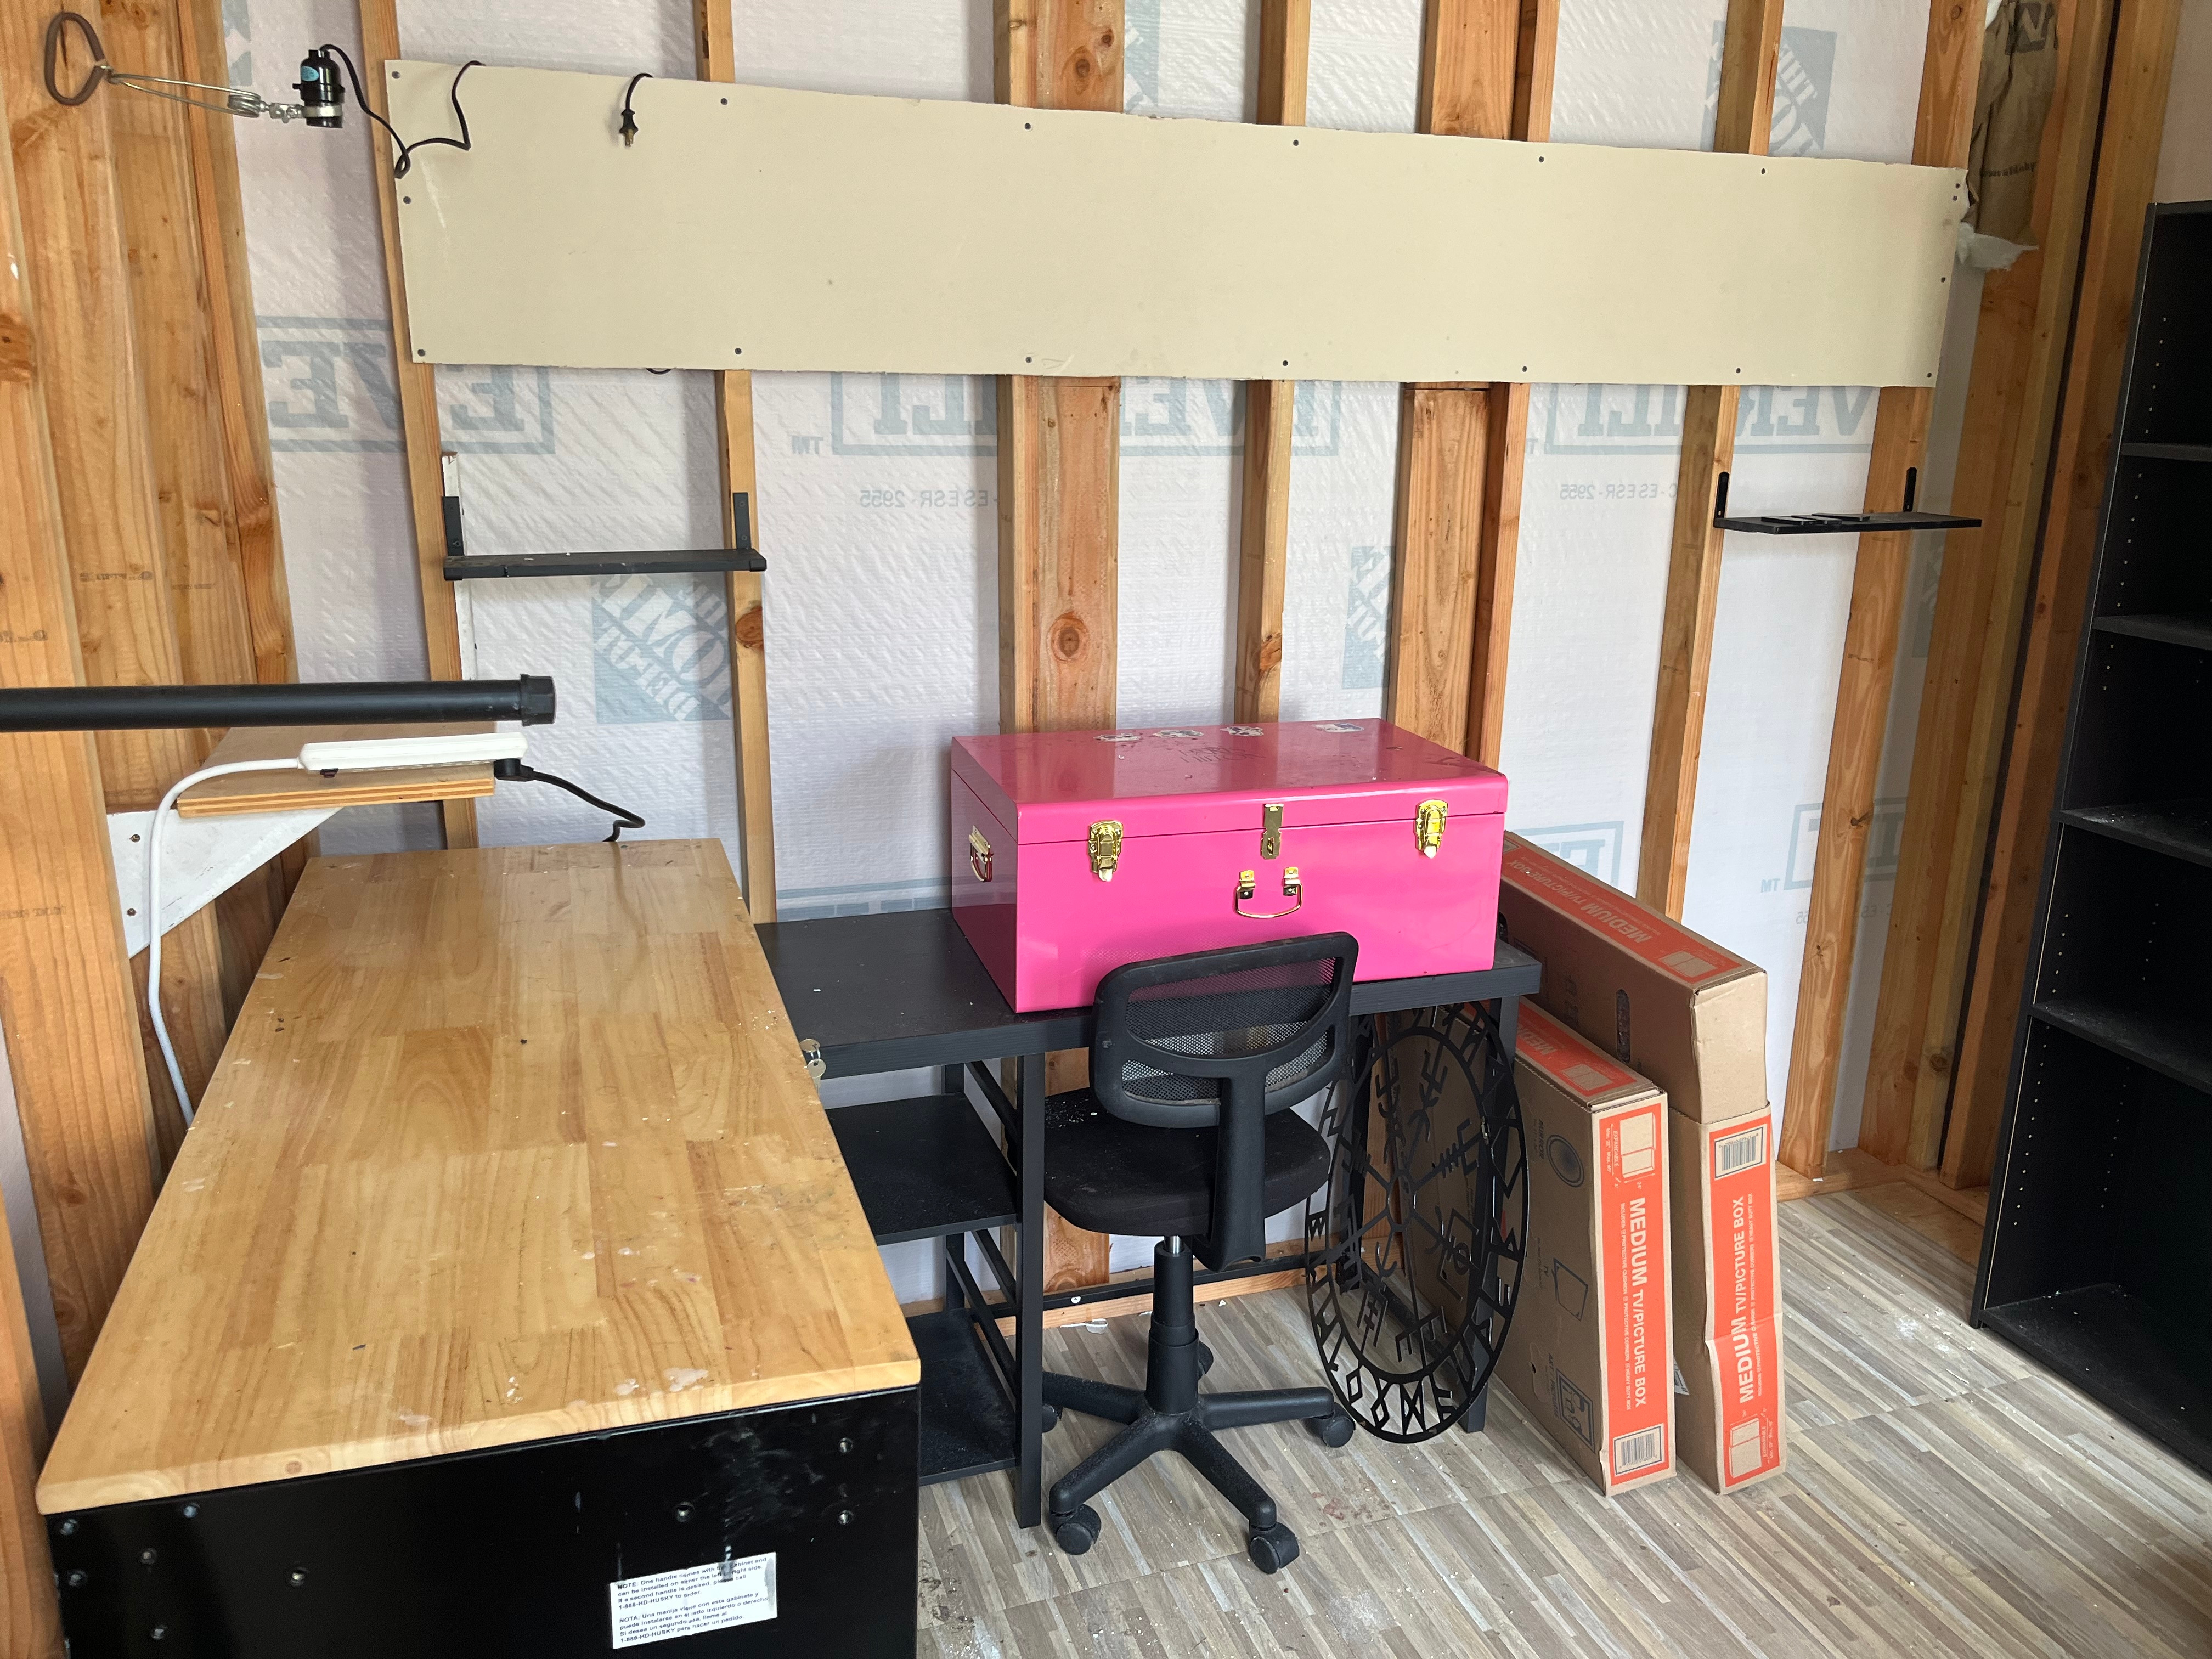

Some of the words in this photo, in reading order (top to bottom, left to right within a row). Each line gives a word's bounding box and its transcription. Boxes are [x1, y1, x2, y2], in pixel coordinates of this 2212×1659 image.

[1581, 901, 1653, 943] MEDIUM
[1732, 1196, 1745, 1228] BOX
[1629, 1197, 1648, 1286] MEDIUM
[1733, 1231, 1747, 1314] TV/PICTURE
[1633, 1289, 1645, 1374] TV/PICTURE
[1731, 1316, 1754, 1403] MEDIUM
[1752, 1332, 1761, 1368] PROTECTIVE
[1635, 1376, 1646, 1407] BOX
[630, 1592, 653, 1600] second
[641, 1583, 669, 1592] installed
[726, 1593, 753, 1602] gabinete
[620, 1622, 640, 1631] puede
[641, 1617, 673, 1626] instalarse
[707, 1604, 736, 1612] izquierdo
